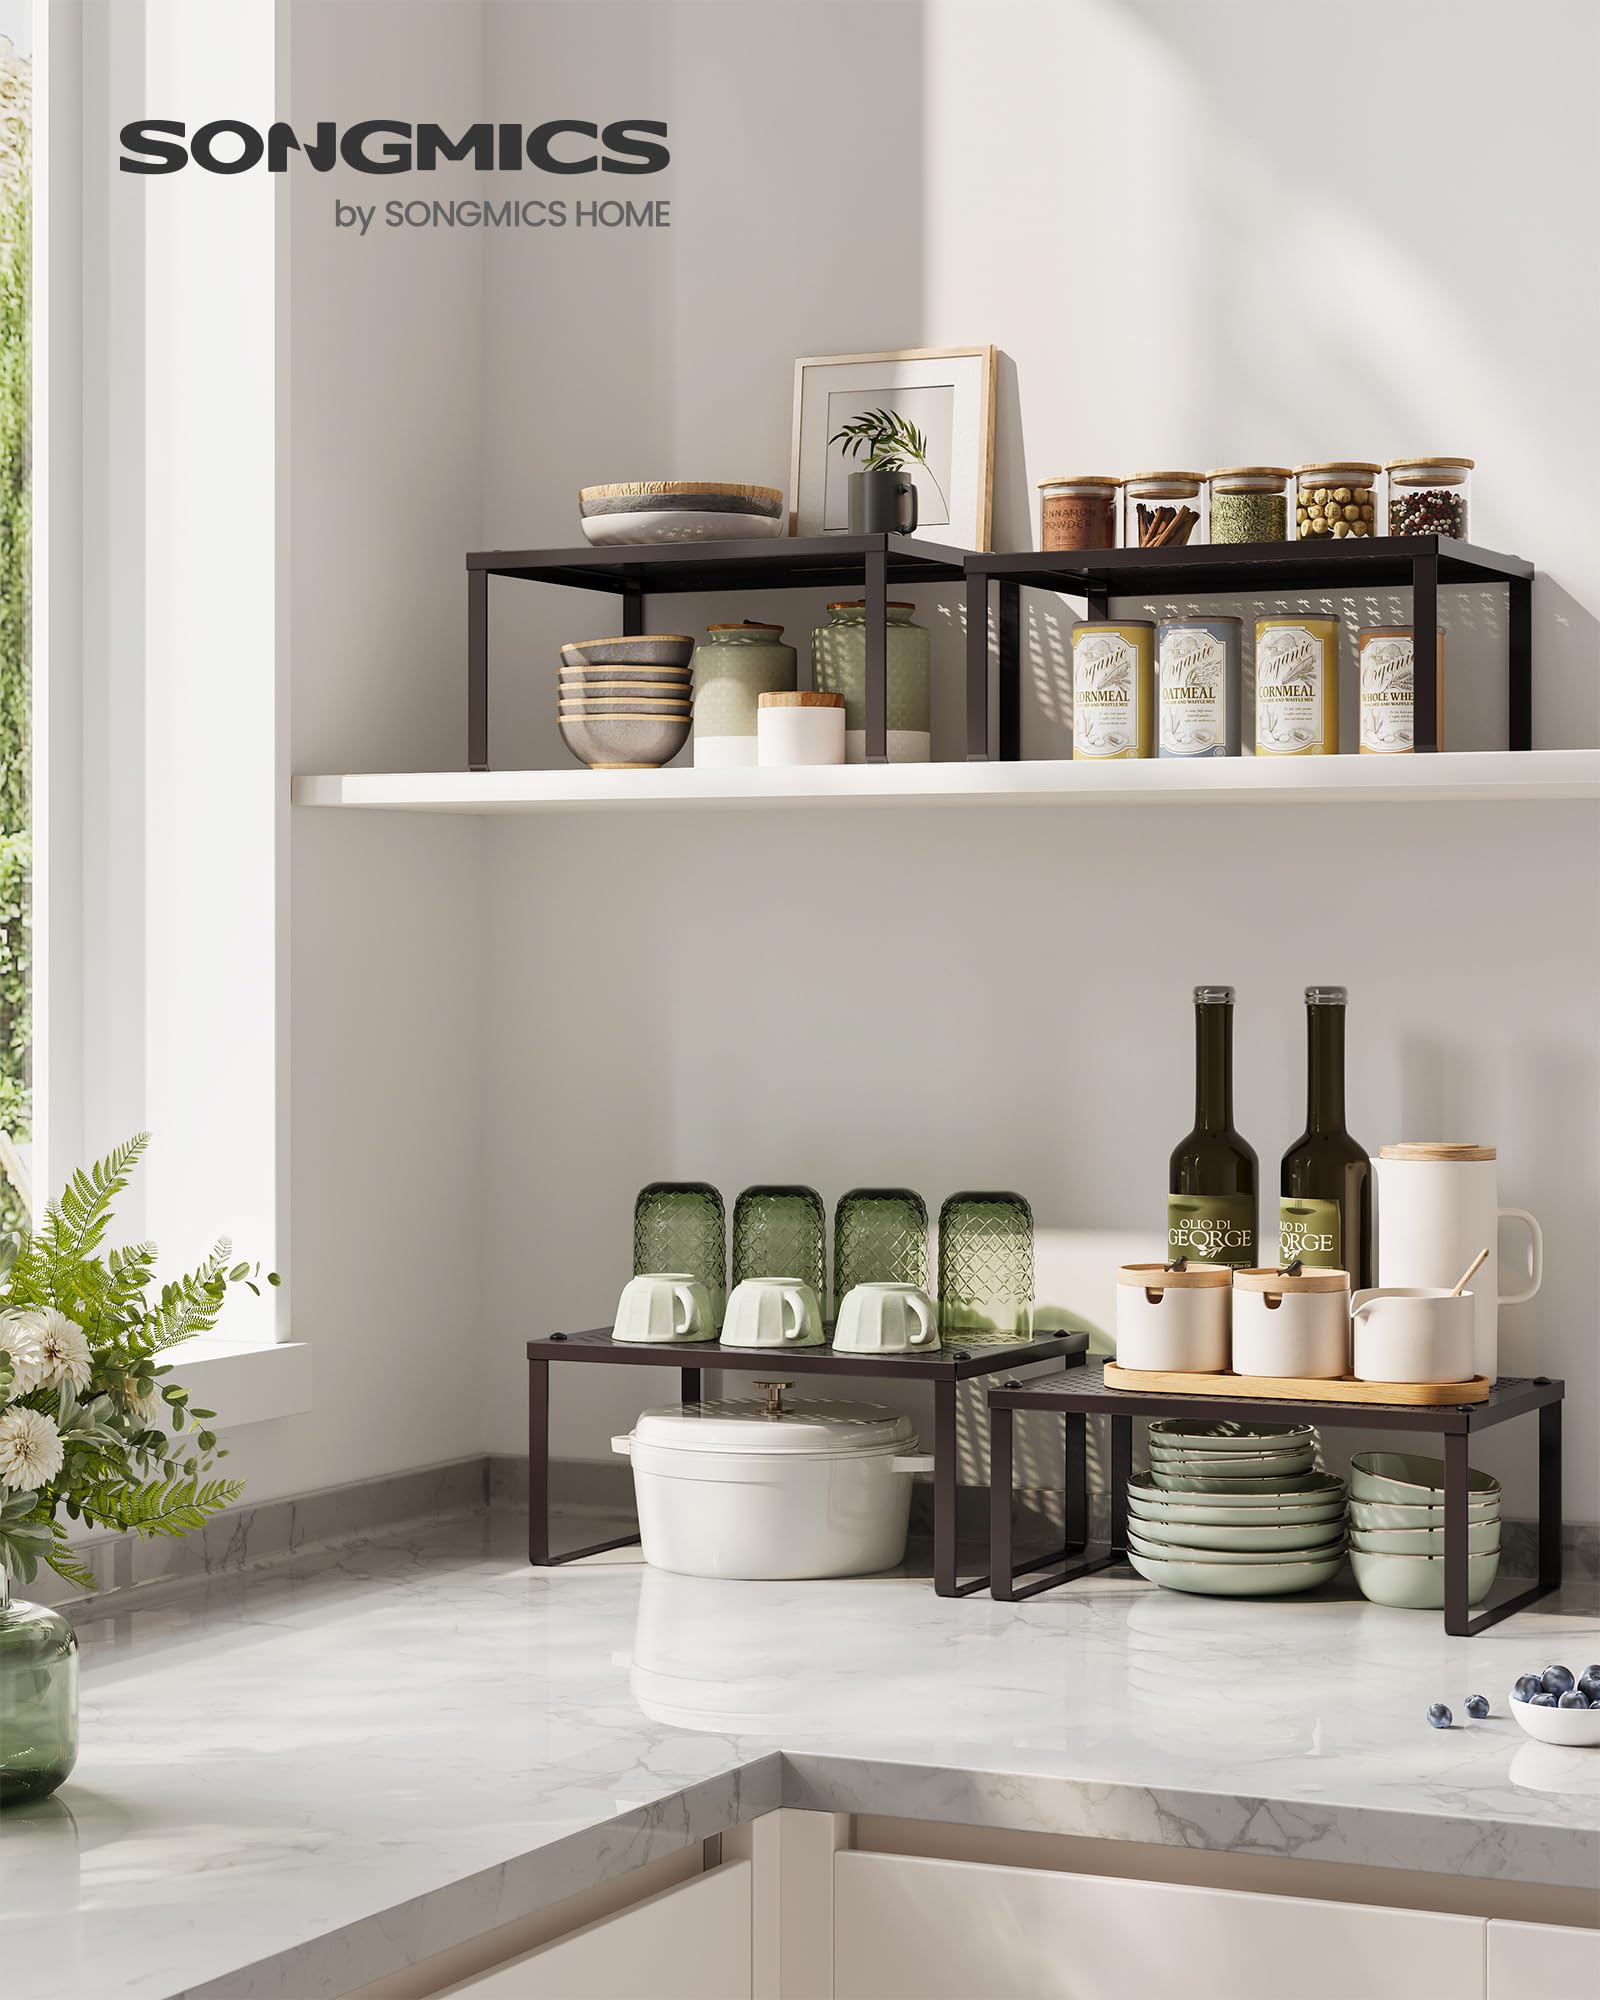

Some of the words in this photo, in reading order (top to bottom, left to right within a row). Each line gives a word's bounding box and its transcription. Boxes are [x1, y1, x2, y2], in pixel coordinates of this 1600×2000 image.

[1044, 520, 1092, 529] POWDER
[1076, 690, 1130, 703] CORNMEAL
[1163, 687, 1216, 699] OATMEAL
[1259, 685, 1315, 697] CORNMEAL
[1390, 692, 1414, 701] WHE
[1180, 1219, 1213, 1229] OLIO
[1216, 1220, 1231, 1229] DI
[1280, 1221, 1293, 1231] LIO
[1294, 1222, 1307, 1232] DI
[1168, 1228, 1252, 1248] GEORGE
[1280, 1231, 1334, 1251] ORGE
